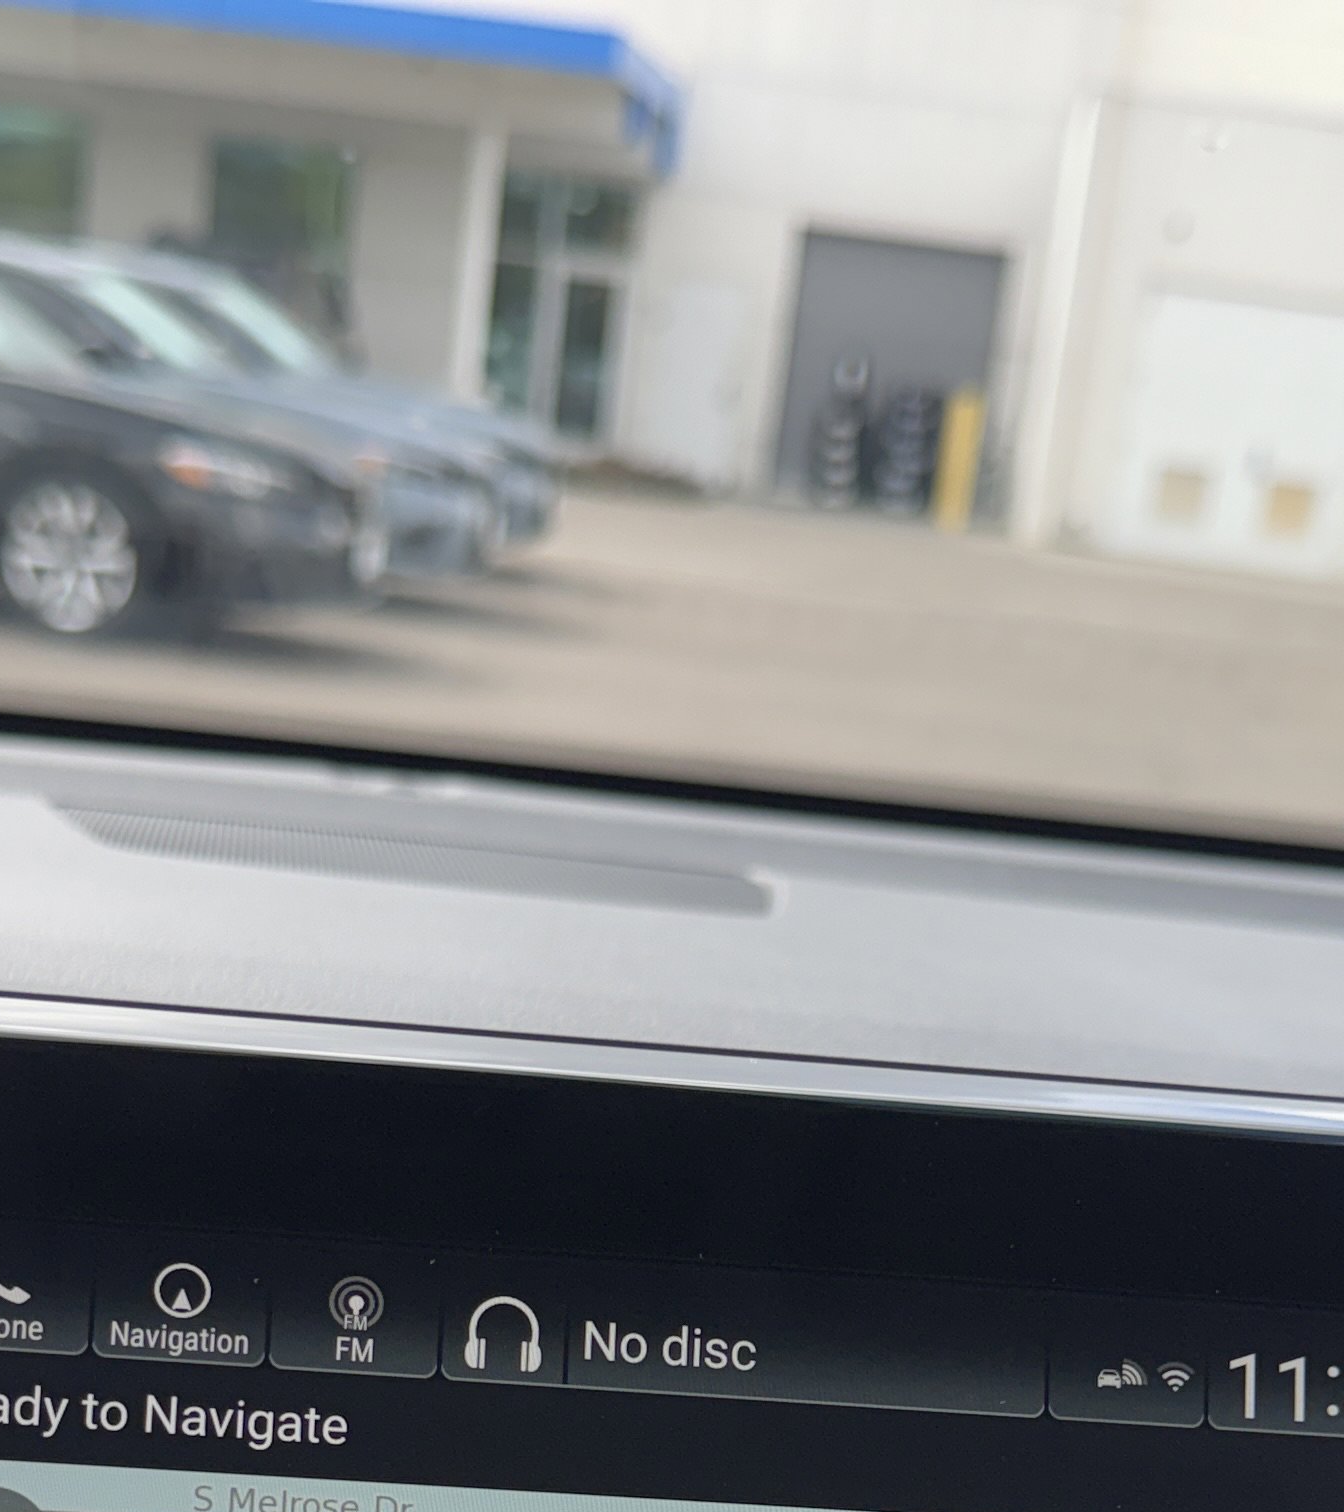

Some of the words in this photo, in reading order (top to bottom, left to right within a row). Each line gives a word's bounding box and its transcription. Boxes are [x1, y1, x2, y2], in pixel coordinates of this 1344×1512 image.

[343, 1314, 368, 1331] FM
[109, 1321, 250, 1356] Navigation
[335, 1336, 374, 1363] FM
[583, 1320, 648, 1364] No
[662, 1325, 758, 1370] disc
[81, 1394, 128, 1432] to
[144, 1396, 349, 1450] Navigate
[193, 1485, 213, 1512] S
